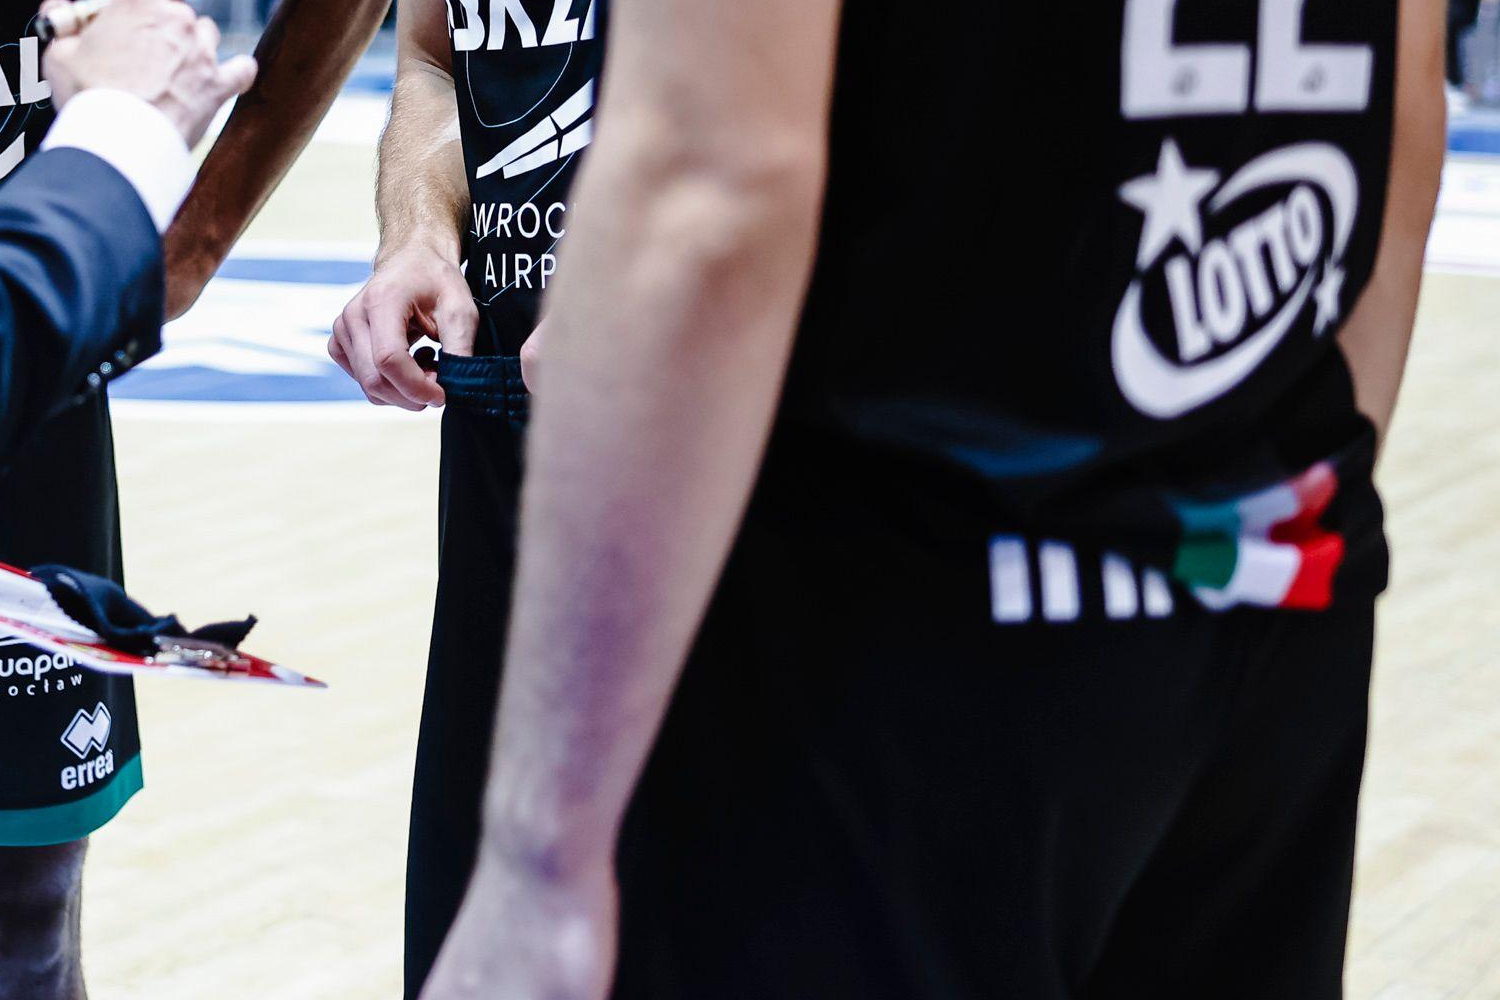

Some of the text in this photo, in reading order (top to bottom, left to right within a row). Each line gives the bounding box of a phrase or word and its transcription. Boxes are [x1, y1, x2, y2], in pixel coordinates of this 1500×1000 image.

[472, 201, 567, 239] WROC
[484, 252, 557, 289] AIRP
[1164, 186, 1322, 363] LOTTO
